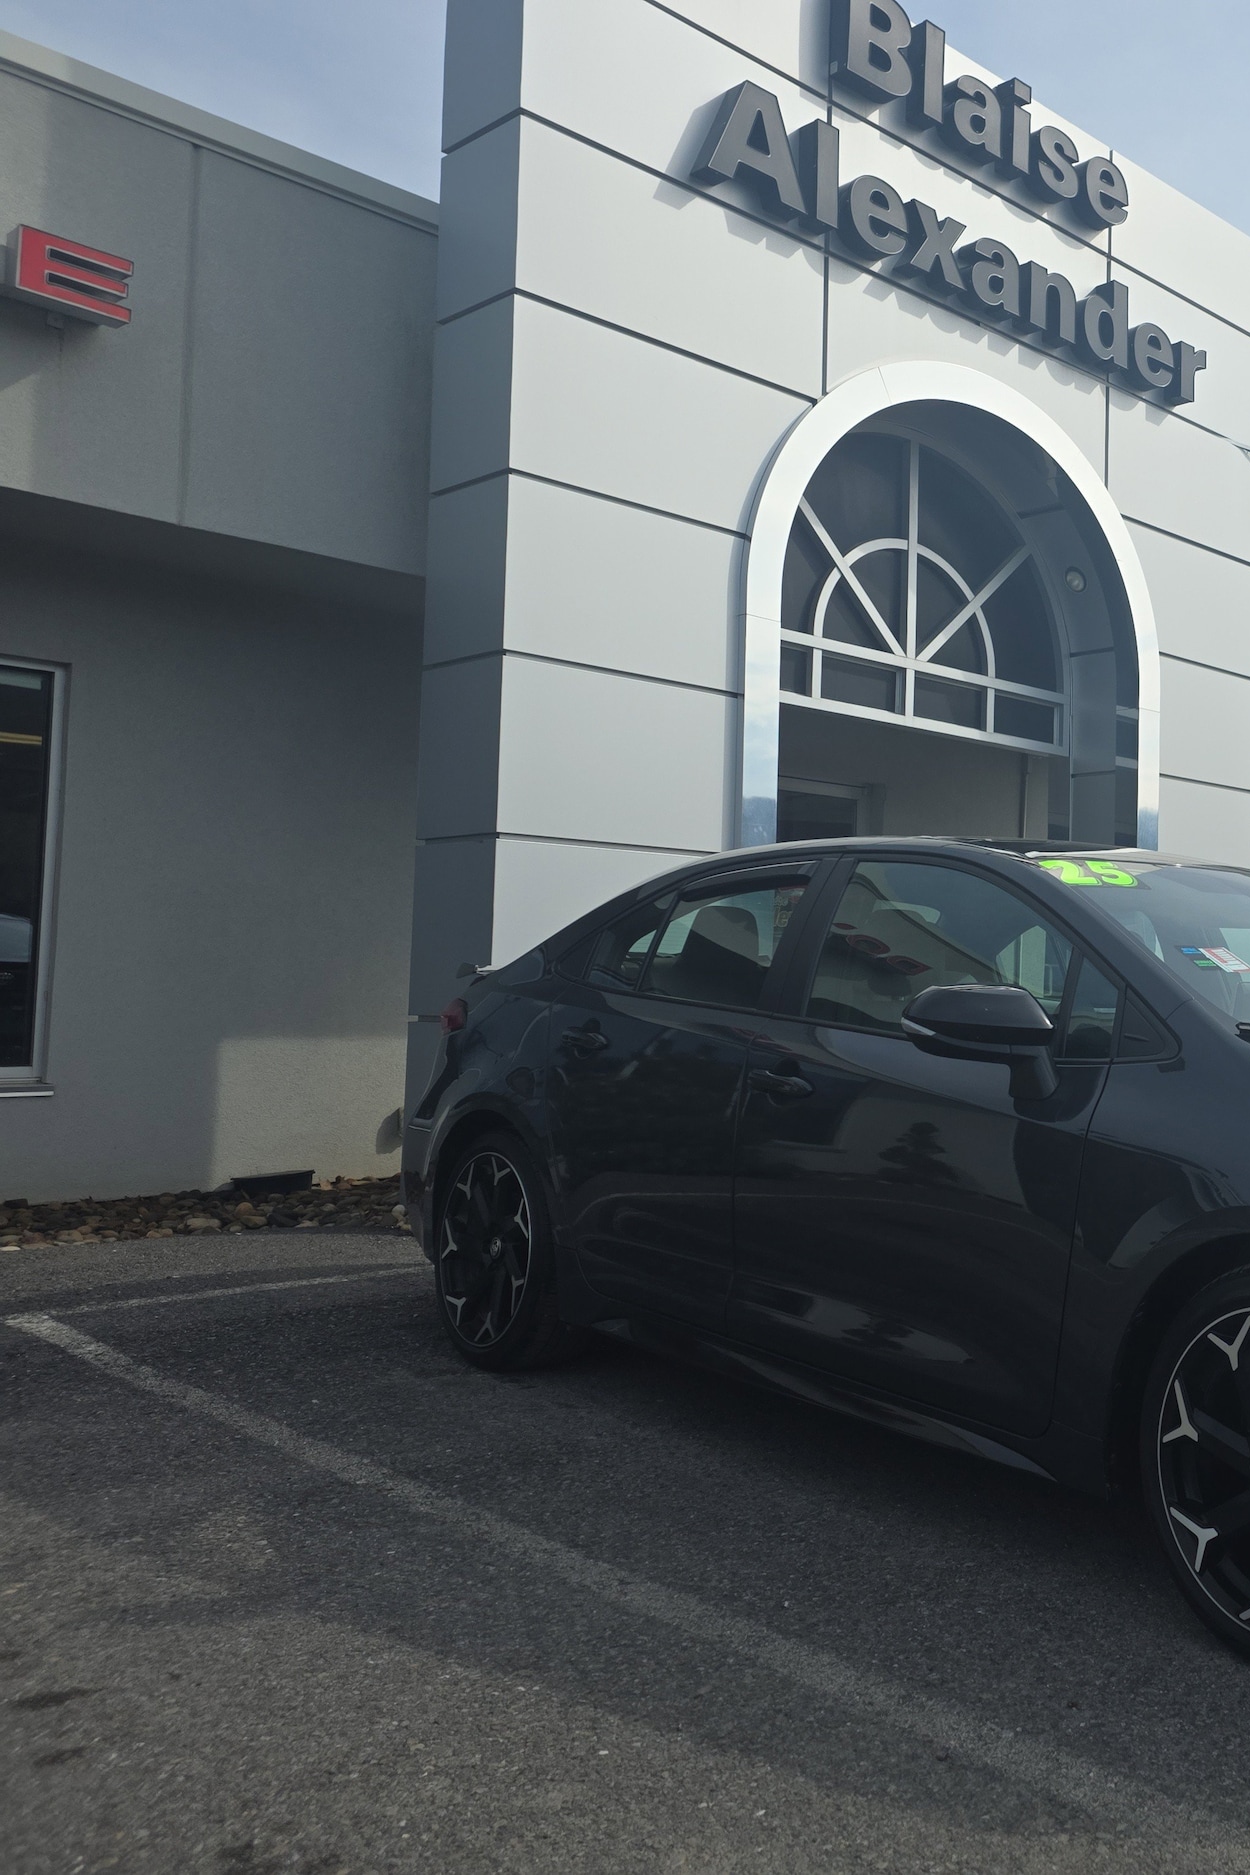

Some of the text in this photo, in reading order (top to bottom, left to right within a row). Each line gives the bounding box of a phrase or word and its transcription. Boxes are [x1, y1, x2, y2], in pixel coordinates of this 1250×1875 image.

[836, 0, 1130, 230] Blaise
[692, 80, 1207, 404] Alexander
[1038, 859, 1139, 887] 25
